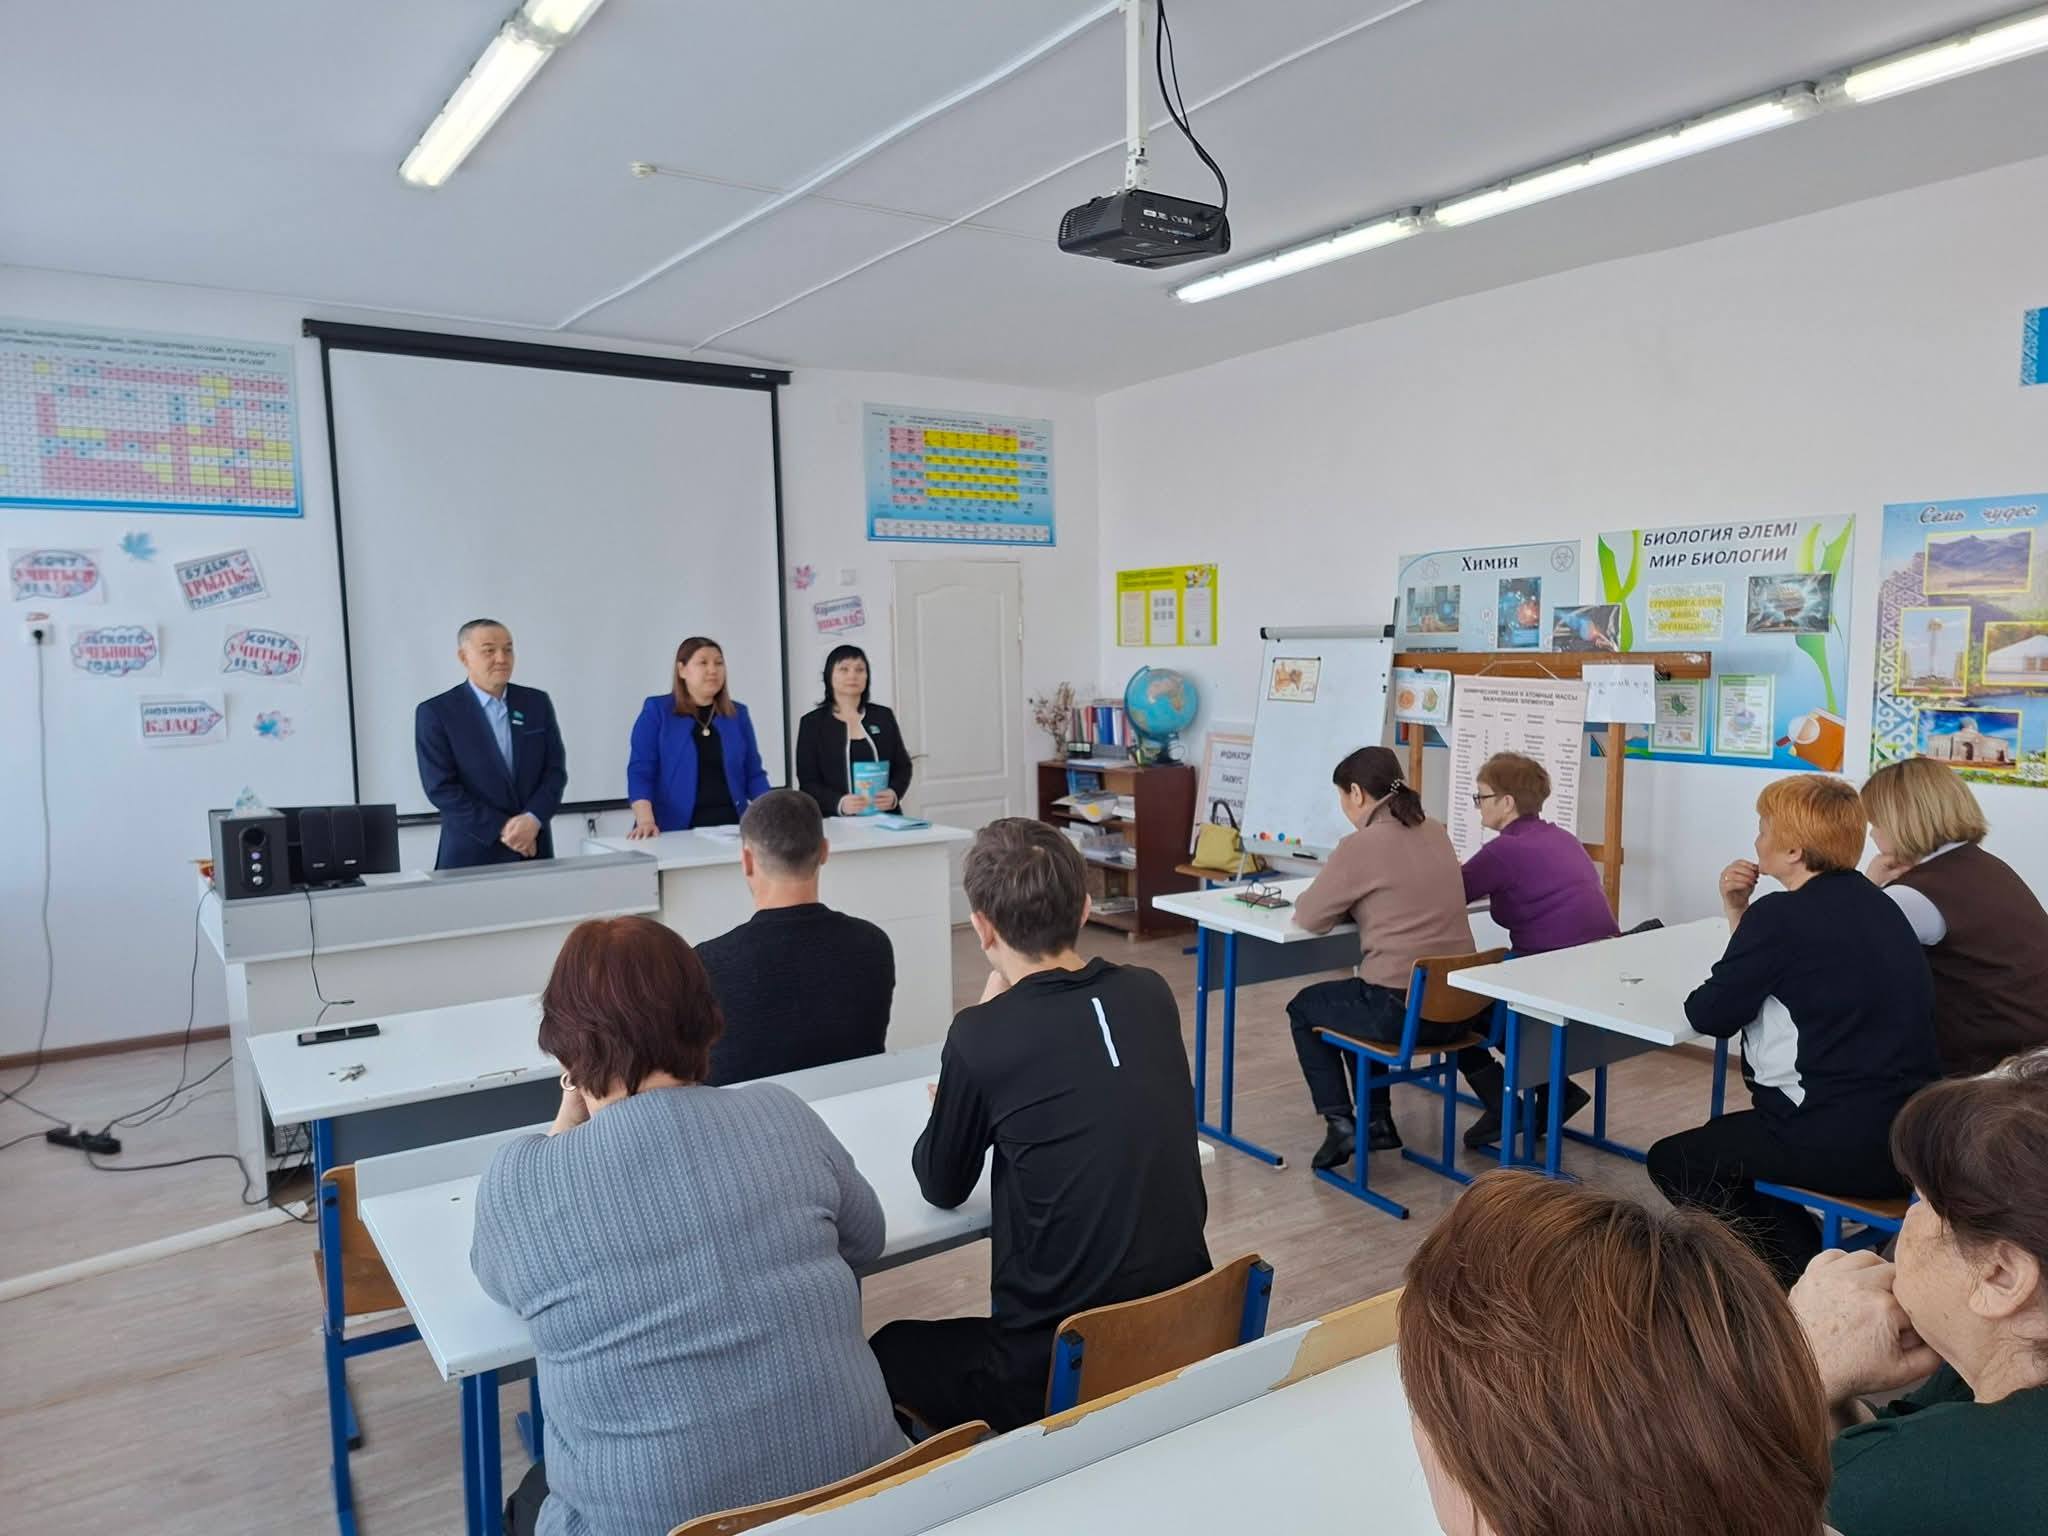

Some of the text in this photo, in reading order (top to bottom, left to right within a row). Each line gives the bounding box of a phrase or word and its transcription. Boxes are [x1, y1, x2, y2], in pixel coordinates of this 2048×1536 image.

[1920, 504, 2037, 525] Семь чудес
[1643, 522, 1798, 547] БИОЛОГИЯ ӘЛЕМІ
[1461, 555, 1520, 572] Химия
[1649, 547, 1788, 569] МИР БИОЛОГИИ
